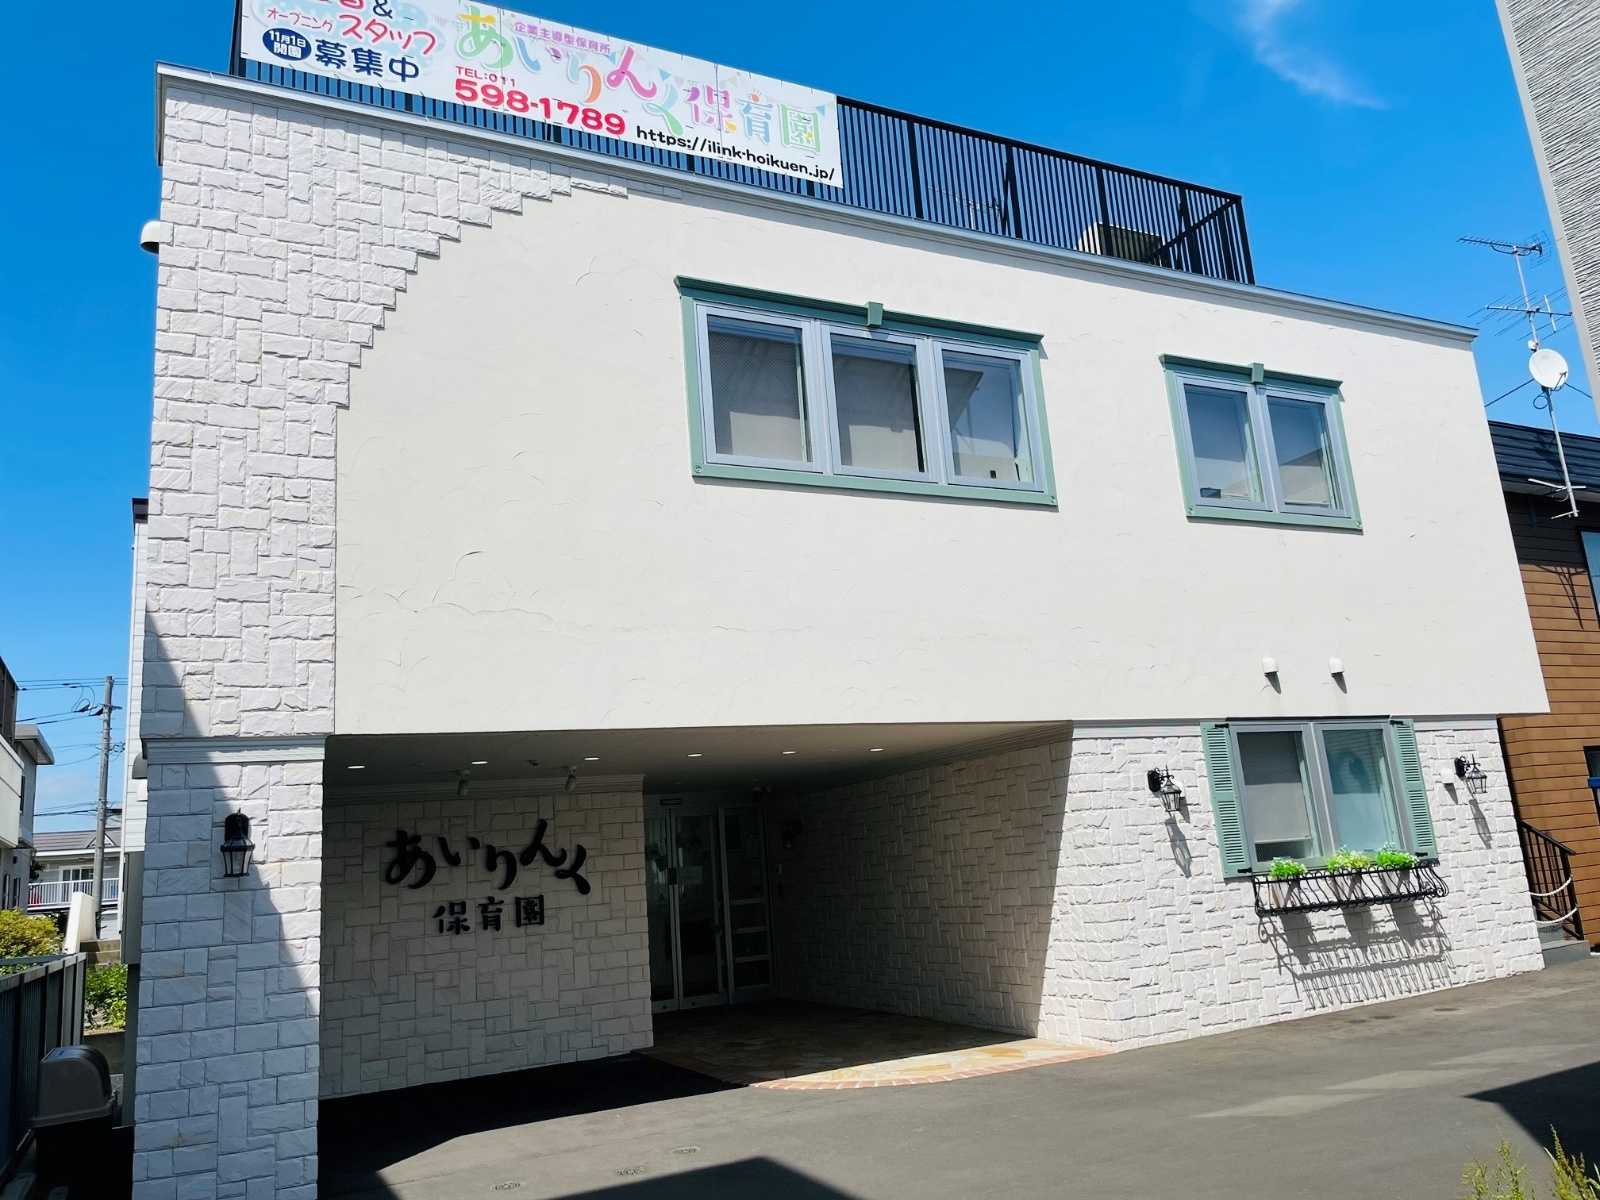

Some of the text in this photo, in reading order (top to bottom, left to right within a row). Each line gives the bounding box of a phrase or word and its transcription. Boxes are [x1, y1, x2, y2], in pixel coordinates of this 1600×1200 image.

[269, 30, 306, 48] 11月1日
[339, 14, 436, 55] スタッフ
[315, 39, 419, 82] 募集中
[455, 79, 626, 136] 598-1789
[636, 125, 835, 181] https://ilink-hoikuen.jp/
[384, 818, 591, 895] あいりんく
[432, 894, 545, 935] 保育園
